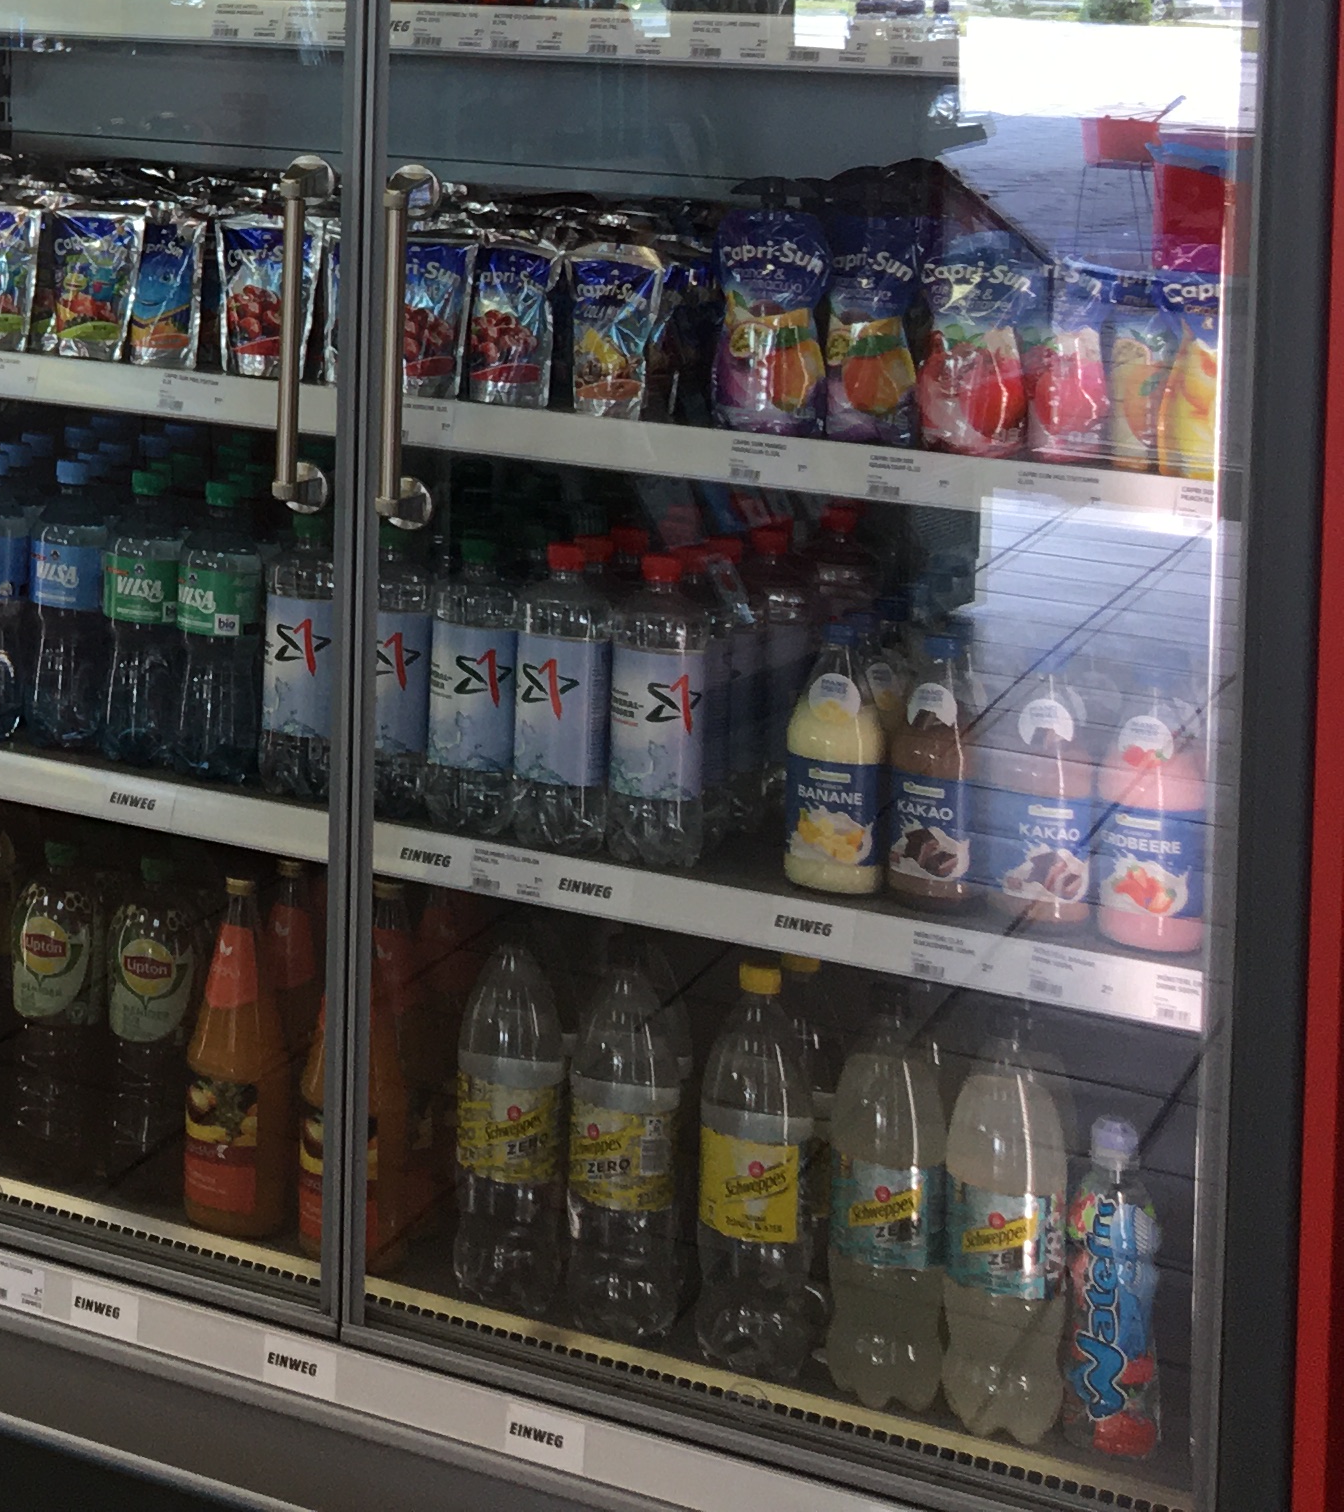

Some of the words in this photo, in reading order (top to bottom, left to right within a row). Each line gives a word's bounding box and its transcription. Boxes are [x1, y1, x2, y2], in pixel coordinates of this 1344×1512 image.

[227, 246, 284, 269] Capri-S
[724, 242, 825, 273] Capri-Sun
[923, 263, 1031, 289] Capri-Sun
[1163, 283, 1219, 303] Capri
[117, 575, 164, 600] VILSA
[218, 617, 236, 631] bio
[110, 791, 156, 811] EINWEG
[798, 785, 863, 807] BANANE
[896, 799, 953, 822] KAKAO
[1019, 822, 1080, 843] KAKAO
[400, 848, 452, 867] EINWEG
[558, 876, 612, 899] EINWEG
[774, 913, 832, 937] EINWEG
[25, 935, 65, 957] Lipton
[125, 958, 169, 978] Lipton
[587, 1159, 631, 1175] ZERO
[725, 1169, 787, 1196] Schweppes
[852, 1197, 915, 1220] Schweppes
[74, 1295, 121, 1320] EINWEG
[267, 1351, 318, 1376] EINWEG
[509, 1421, 564, 1450] EINWEG
